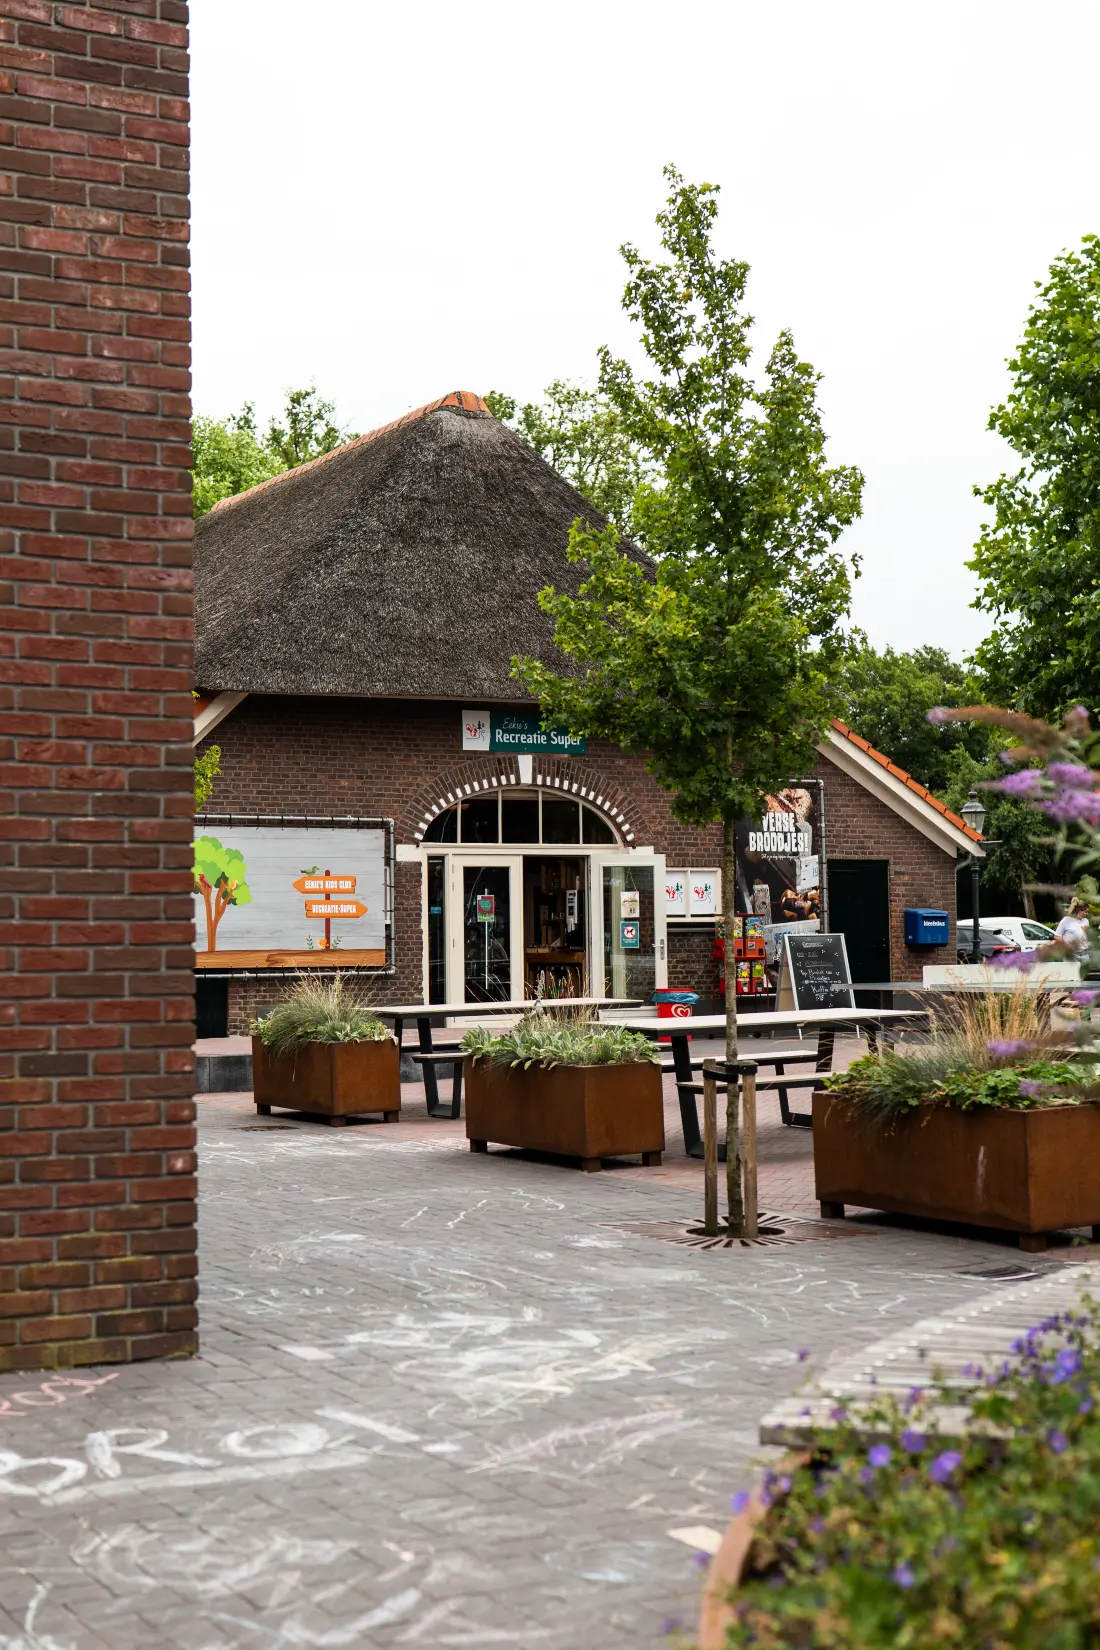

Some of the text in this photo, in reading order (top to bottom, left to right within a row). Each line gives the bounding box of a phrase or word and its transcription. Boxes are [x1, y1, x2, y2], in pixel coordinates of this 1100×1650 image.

[495, 728, 582, 749] Recreatie Super
[762, 812, 796, 832] VERSE
[748, 831, 809, 852] BROODJES!
[325, 880, 338, 889] KIDS
[339, 880, 352, 889] CLUB
